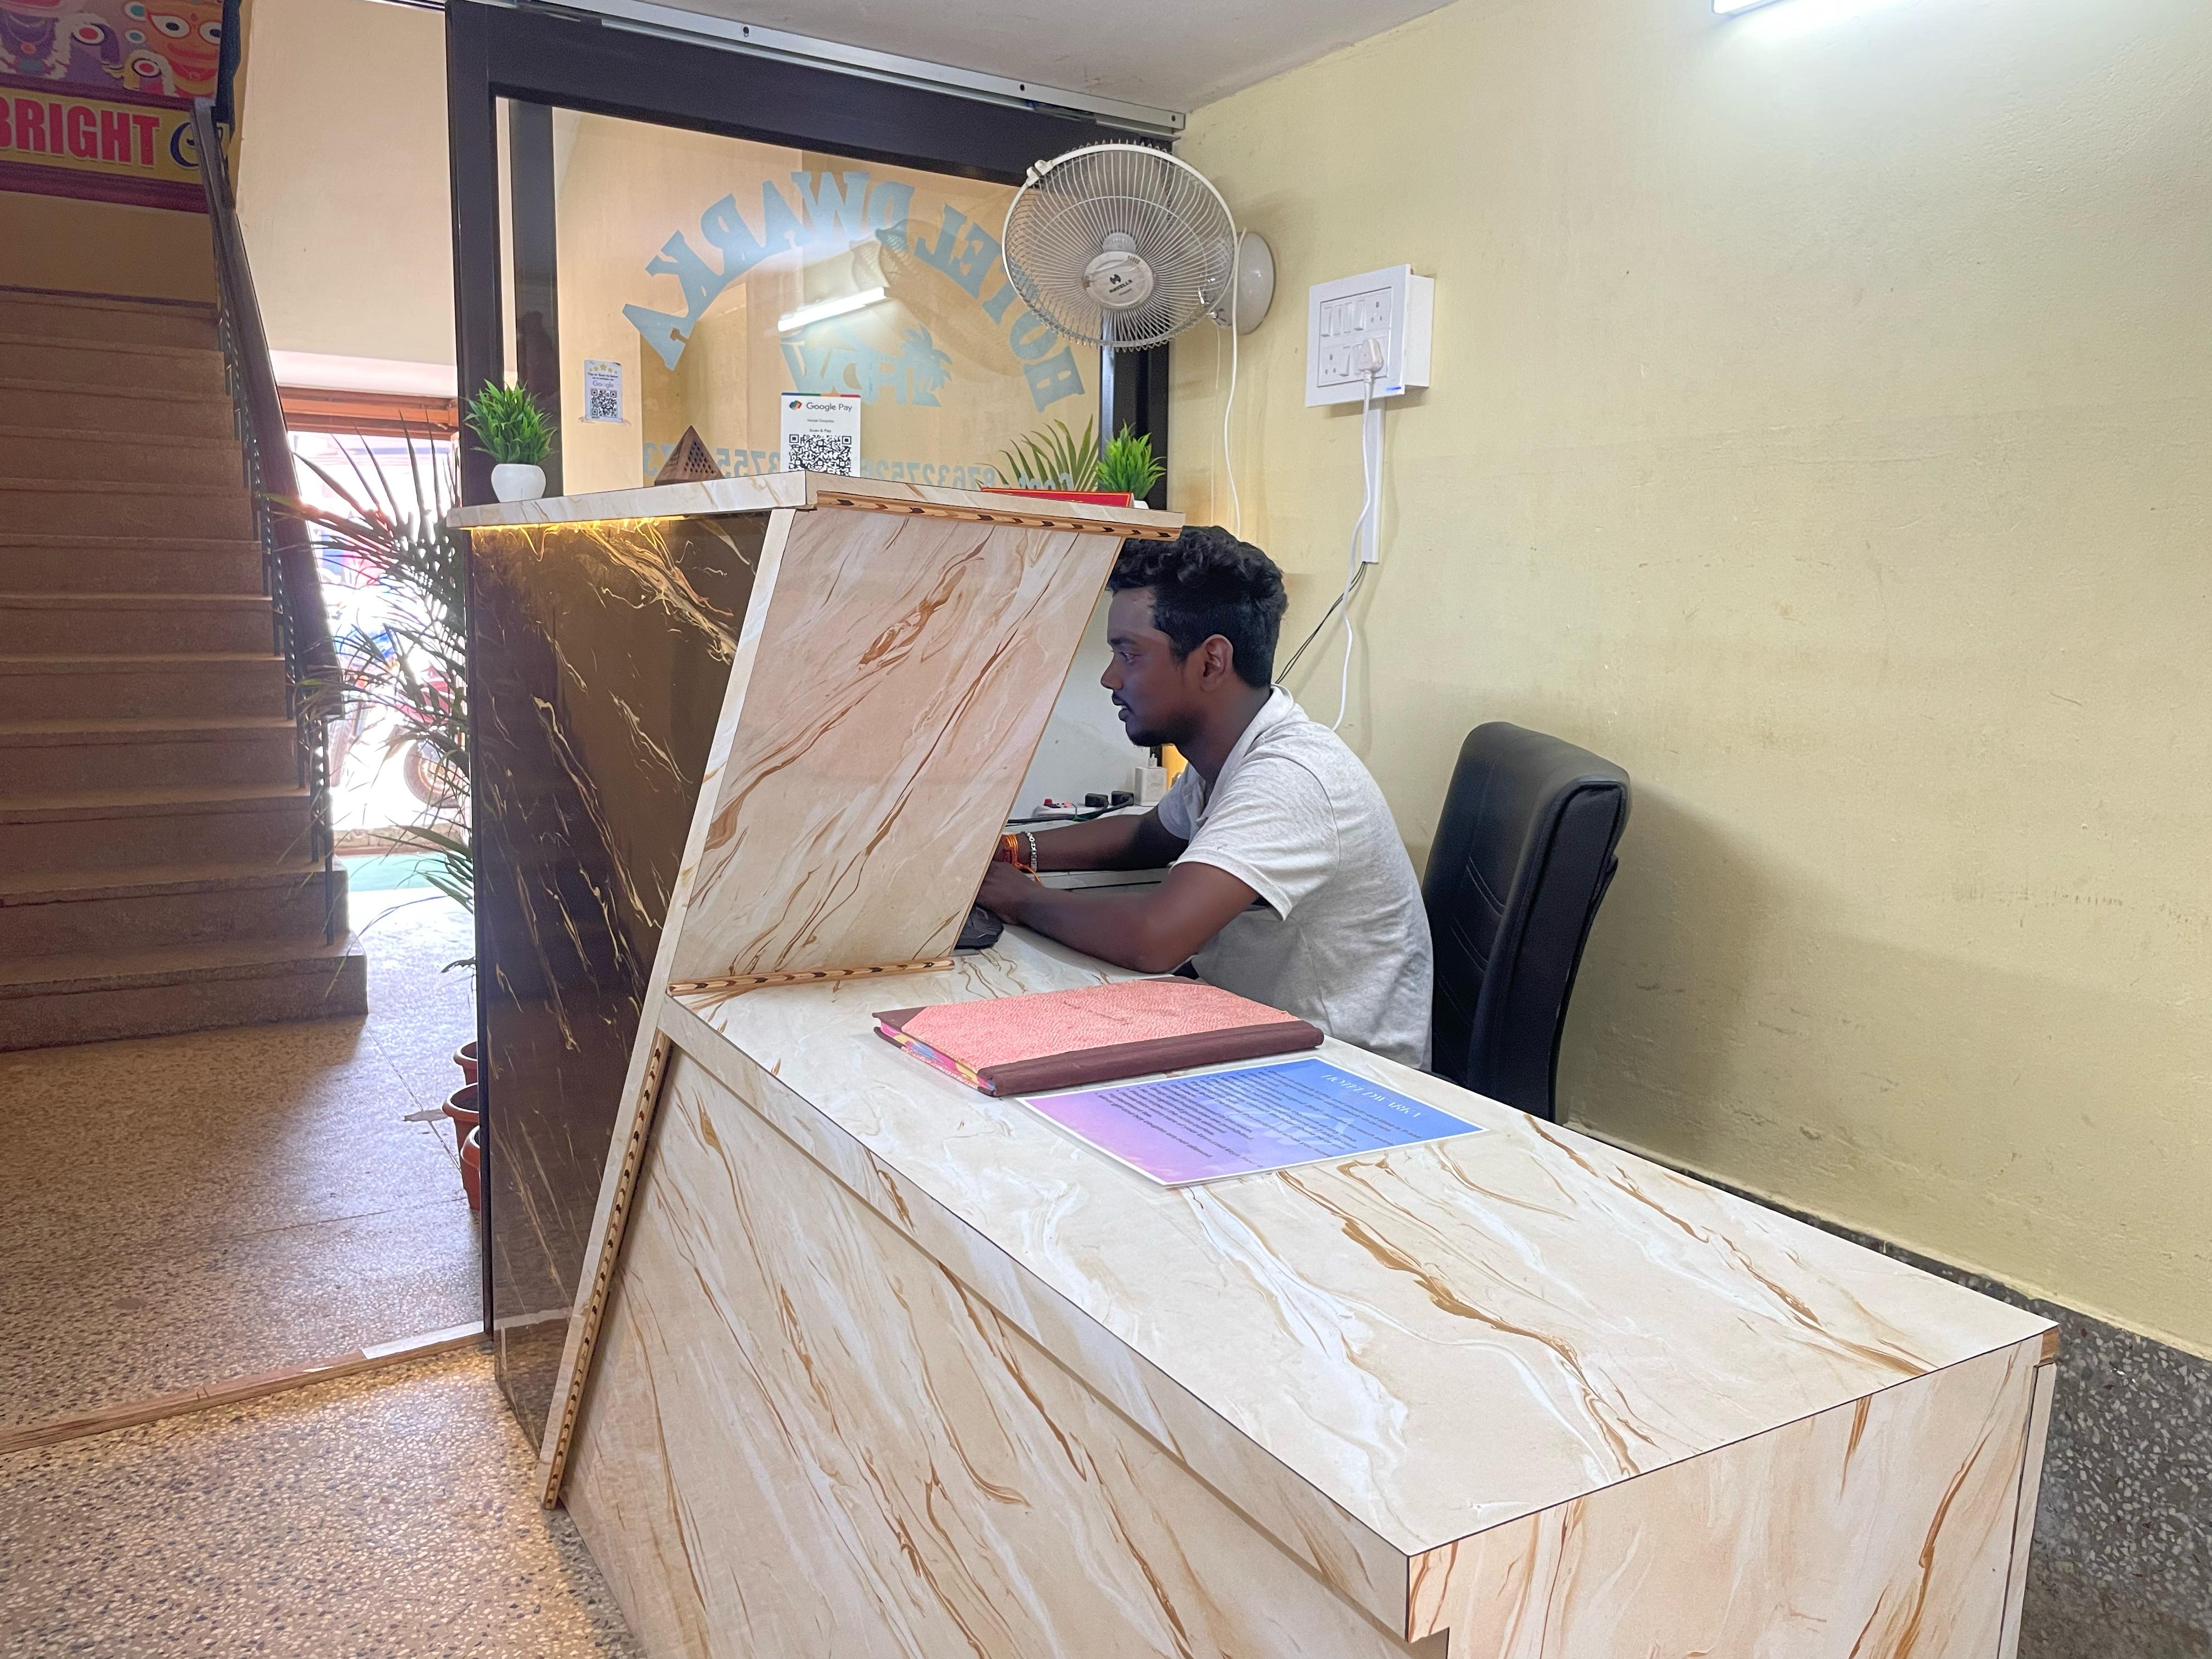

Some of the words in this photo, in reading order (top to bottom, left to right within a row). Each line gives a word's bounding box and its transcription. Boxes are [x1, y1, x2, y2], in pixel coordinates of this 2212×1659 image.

[592, 380, 614, 389] Gogle
[806, 402, 836, 411] Google
[838, 403, 853, 412] Pay
